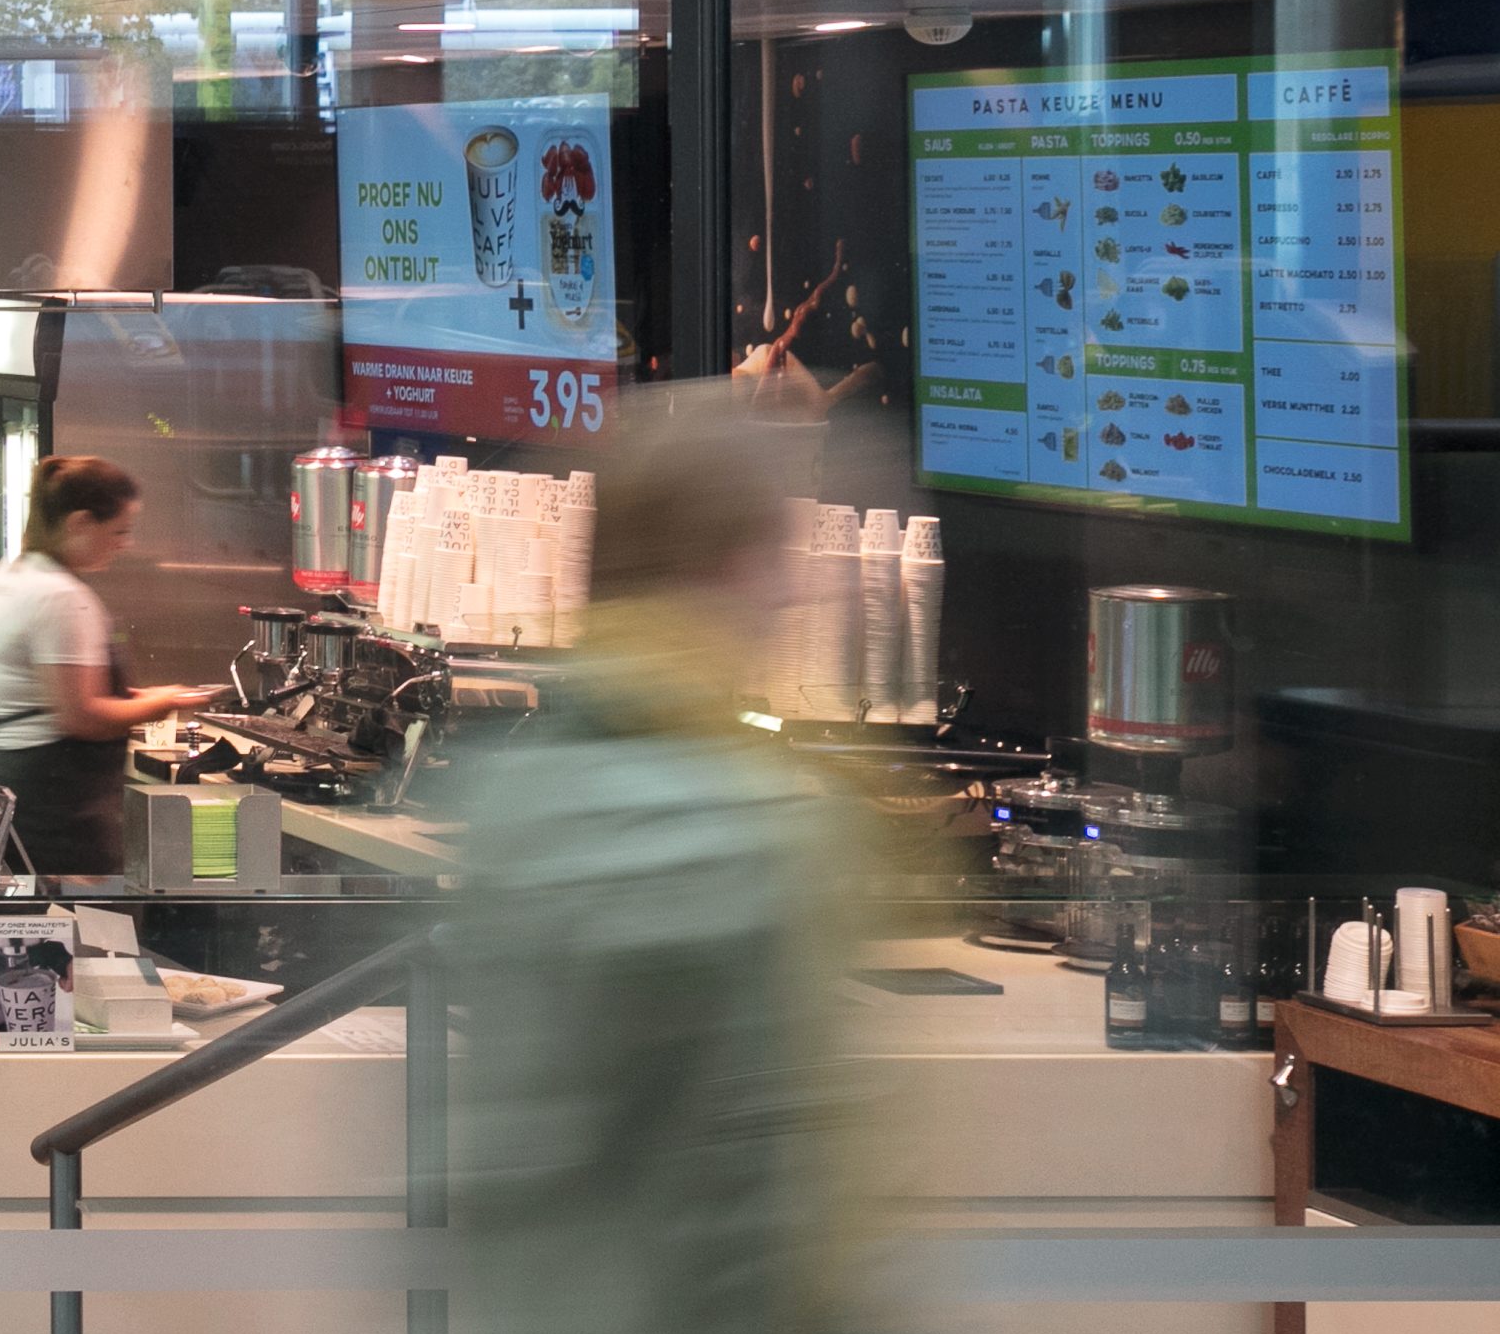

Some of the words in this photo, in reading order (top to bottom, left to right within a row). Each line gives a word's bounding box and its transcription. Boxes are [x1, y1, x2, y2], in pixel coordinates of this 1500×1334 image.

[1284, 78, 1352, 103] CAFFÈ
[973, 97, 1029, 115] PASTA
[1041, 94, 1099, 113] KEUZE
[1111, 92, 1164, 109] MENU
[1030, 135, 1069, 150] PASTA
[1091, 133, 1150, 148] TOPPINGS
[1174, 132, 1201, 146] 0.50
[1361, 131, 1391, 141] DOPPIO
[924, 138, 953, 152] SAUS
[1336, 169, 1353, 179] 2.10
[1364, 169, 1382, 179] 2.75
[358, 182, 411, 207] PROEF
[417, 181, 443, 207] NU
[1257, 203, 1299, 213] ESPRESSO
[1337, 202, 1354, 213] 2.10
[1364, 202, 1382, 213] 2.75
[382, 219, 418, 244] ONS
[1258, 236, 1311, 246] CAPPUCCINO
[1338, 236, 1356, 246] 2.50
[1365, 237, 1384, 247] 3.00
[365, 256, 439, 282] ONTBIJT
[1259, 268, 1285, 278] LATTE
[1287, 269, 1334, 279] MACCHIATO
[1338, 270, 1357, 280] 2.50
[1366, 270, 1385, 280] 3.00
[1260, 302, 1304, 312] RISTRETTO
[1339, 303, 1357, 314] 2.75
[1096, 353, 1156, 371] TOPPINGS
[1180, 358, 1206, 374] 0.75
[352, 361, 384, 378] WARME
[385, 363, 416, 380] DRANK
[417, 366, 443, 383] NAAR
[444, 369, 474, 385] KEUZE
[1261, 367, 1282, 377] THEE
[1340, 371, 1359, 381] 2.00
[386, 388, 392, 399] +
[393, 385, 436, 403] YOGHURT
[929, 384, 982, 401] INSALATA
[1262, 400, 1287, 410] VERSE
[1289, 402, 1335, 413] MUNTTHEE
[1342, 405, 1360, 415] 2.20
[1263, 465, 1336, 480] CHOCOLADEMELK
[1343, 472, 1362, 483] 2.50
[1187, 648, 1220, 679] illy
[10, 1037, 70, 1047] JULIA'S
